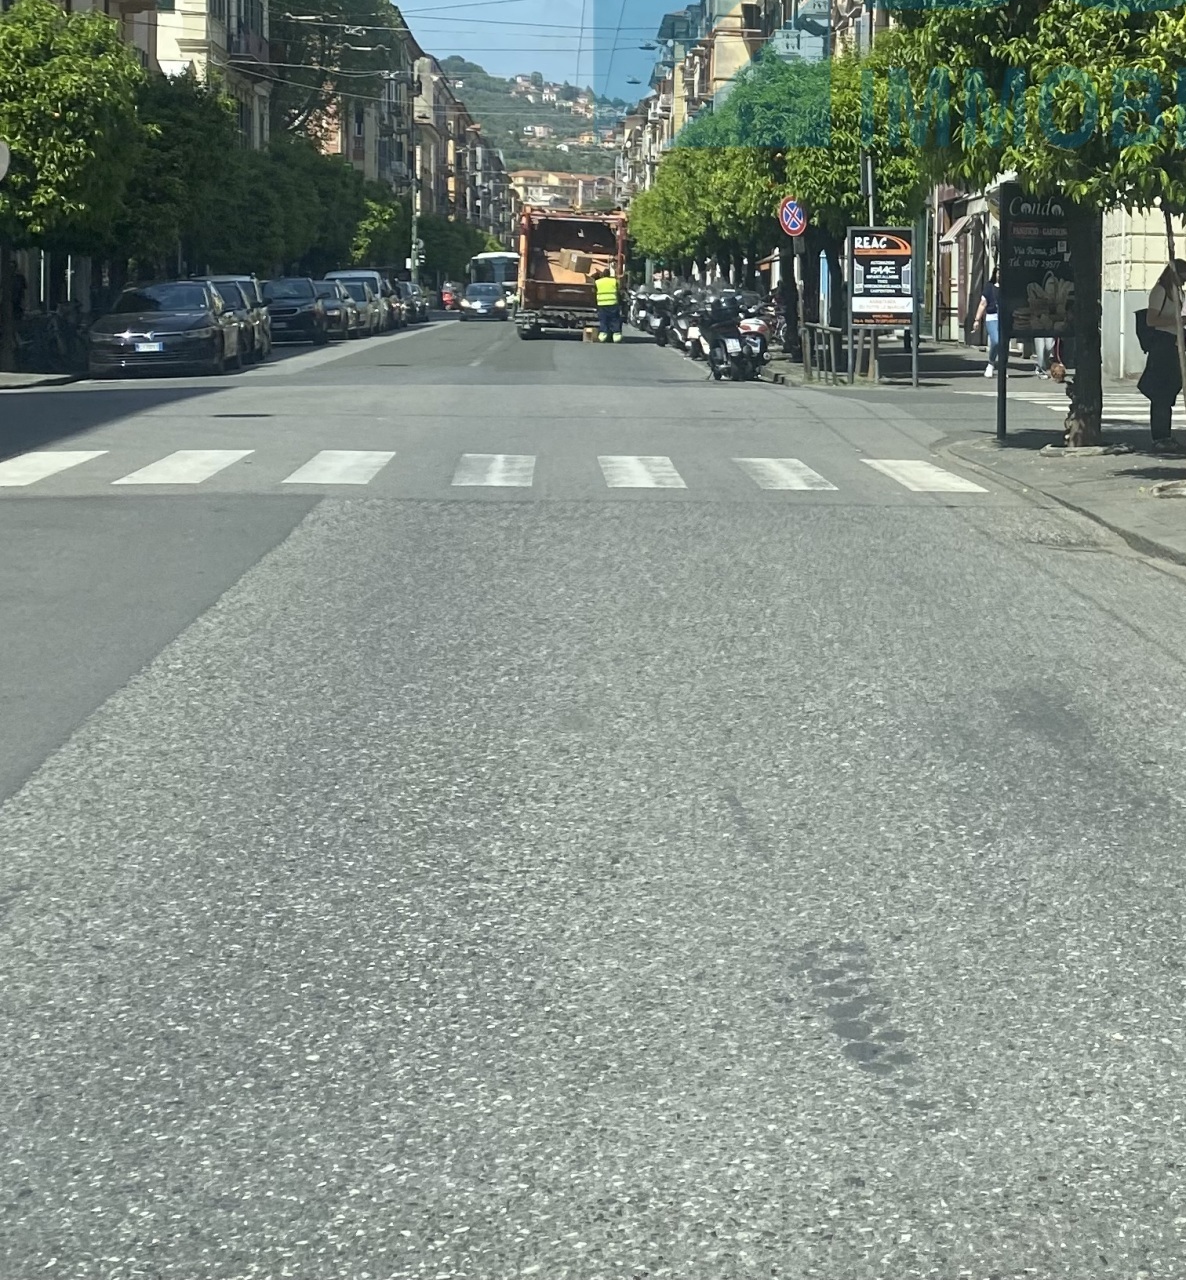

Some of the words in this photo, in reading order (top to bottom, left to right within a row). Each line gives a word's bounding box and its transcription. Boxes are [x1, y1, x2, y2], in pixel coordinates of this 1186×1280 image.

[1009, 196, 1065, 217] Condo
[854, 236, 887, 249] REAC
[1013, 245, 1025, 255] Via
[870, 266, 896, 274] FAAC
